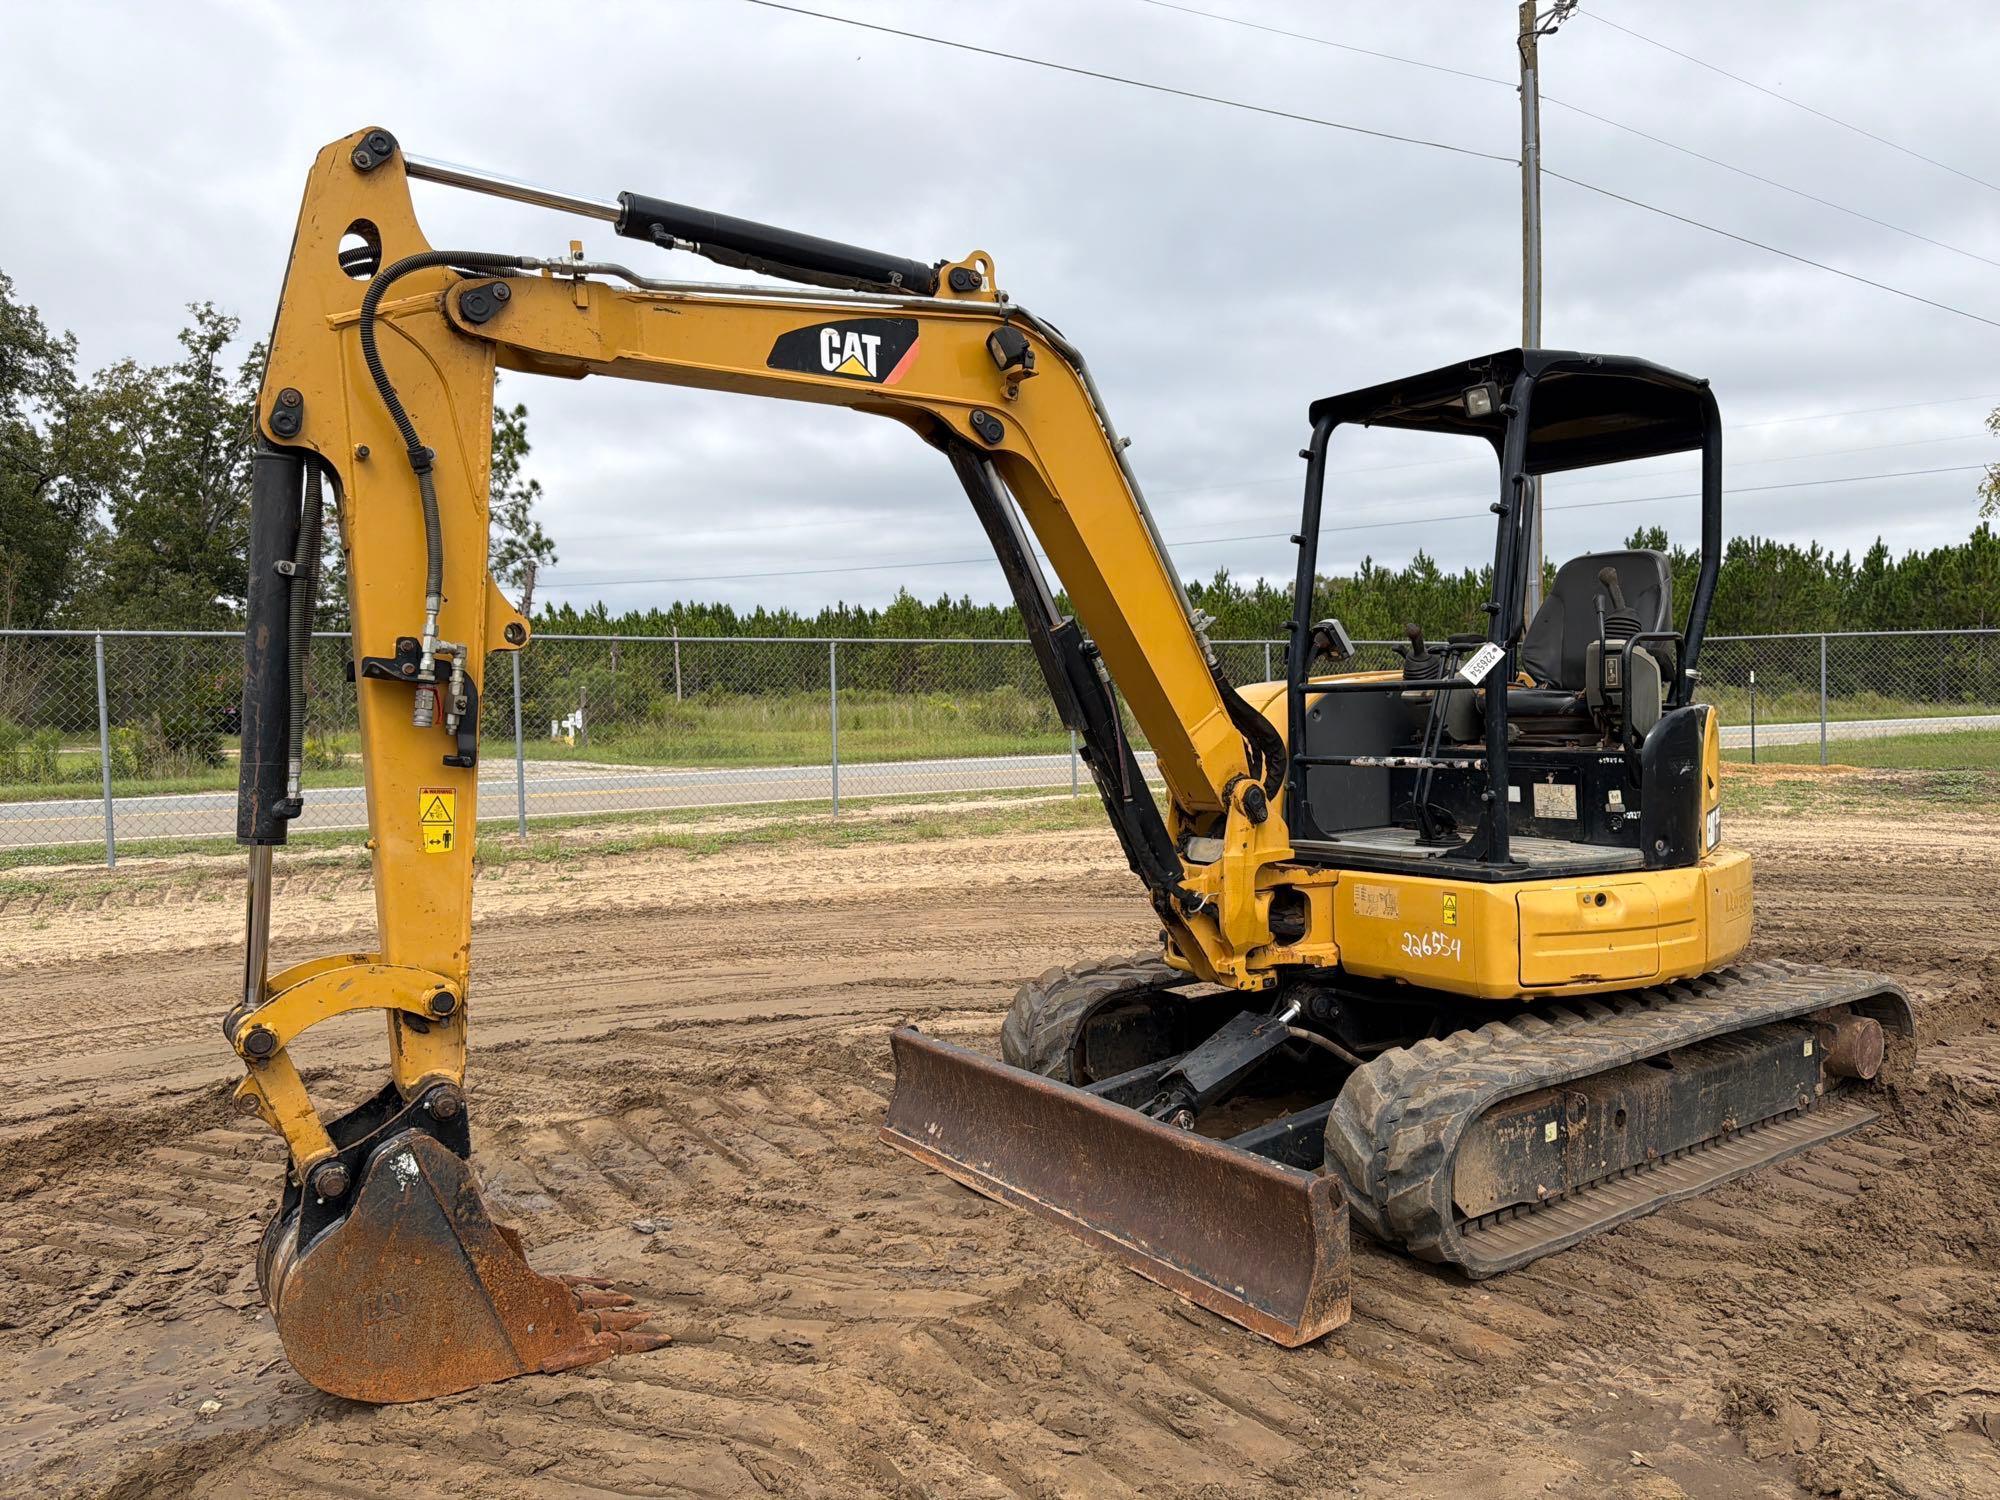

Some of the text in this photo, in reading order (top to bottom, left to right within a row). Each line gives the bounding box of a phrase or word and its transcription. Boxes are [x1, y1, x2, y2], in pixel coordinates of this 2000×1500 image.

[820, 327, 881, 377] CAT
[1470, 651, 1496, 678] 226554
[1401, 931, 1461, 962] 226554
